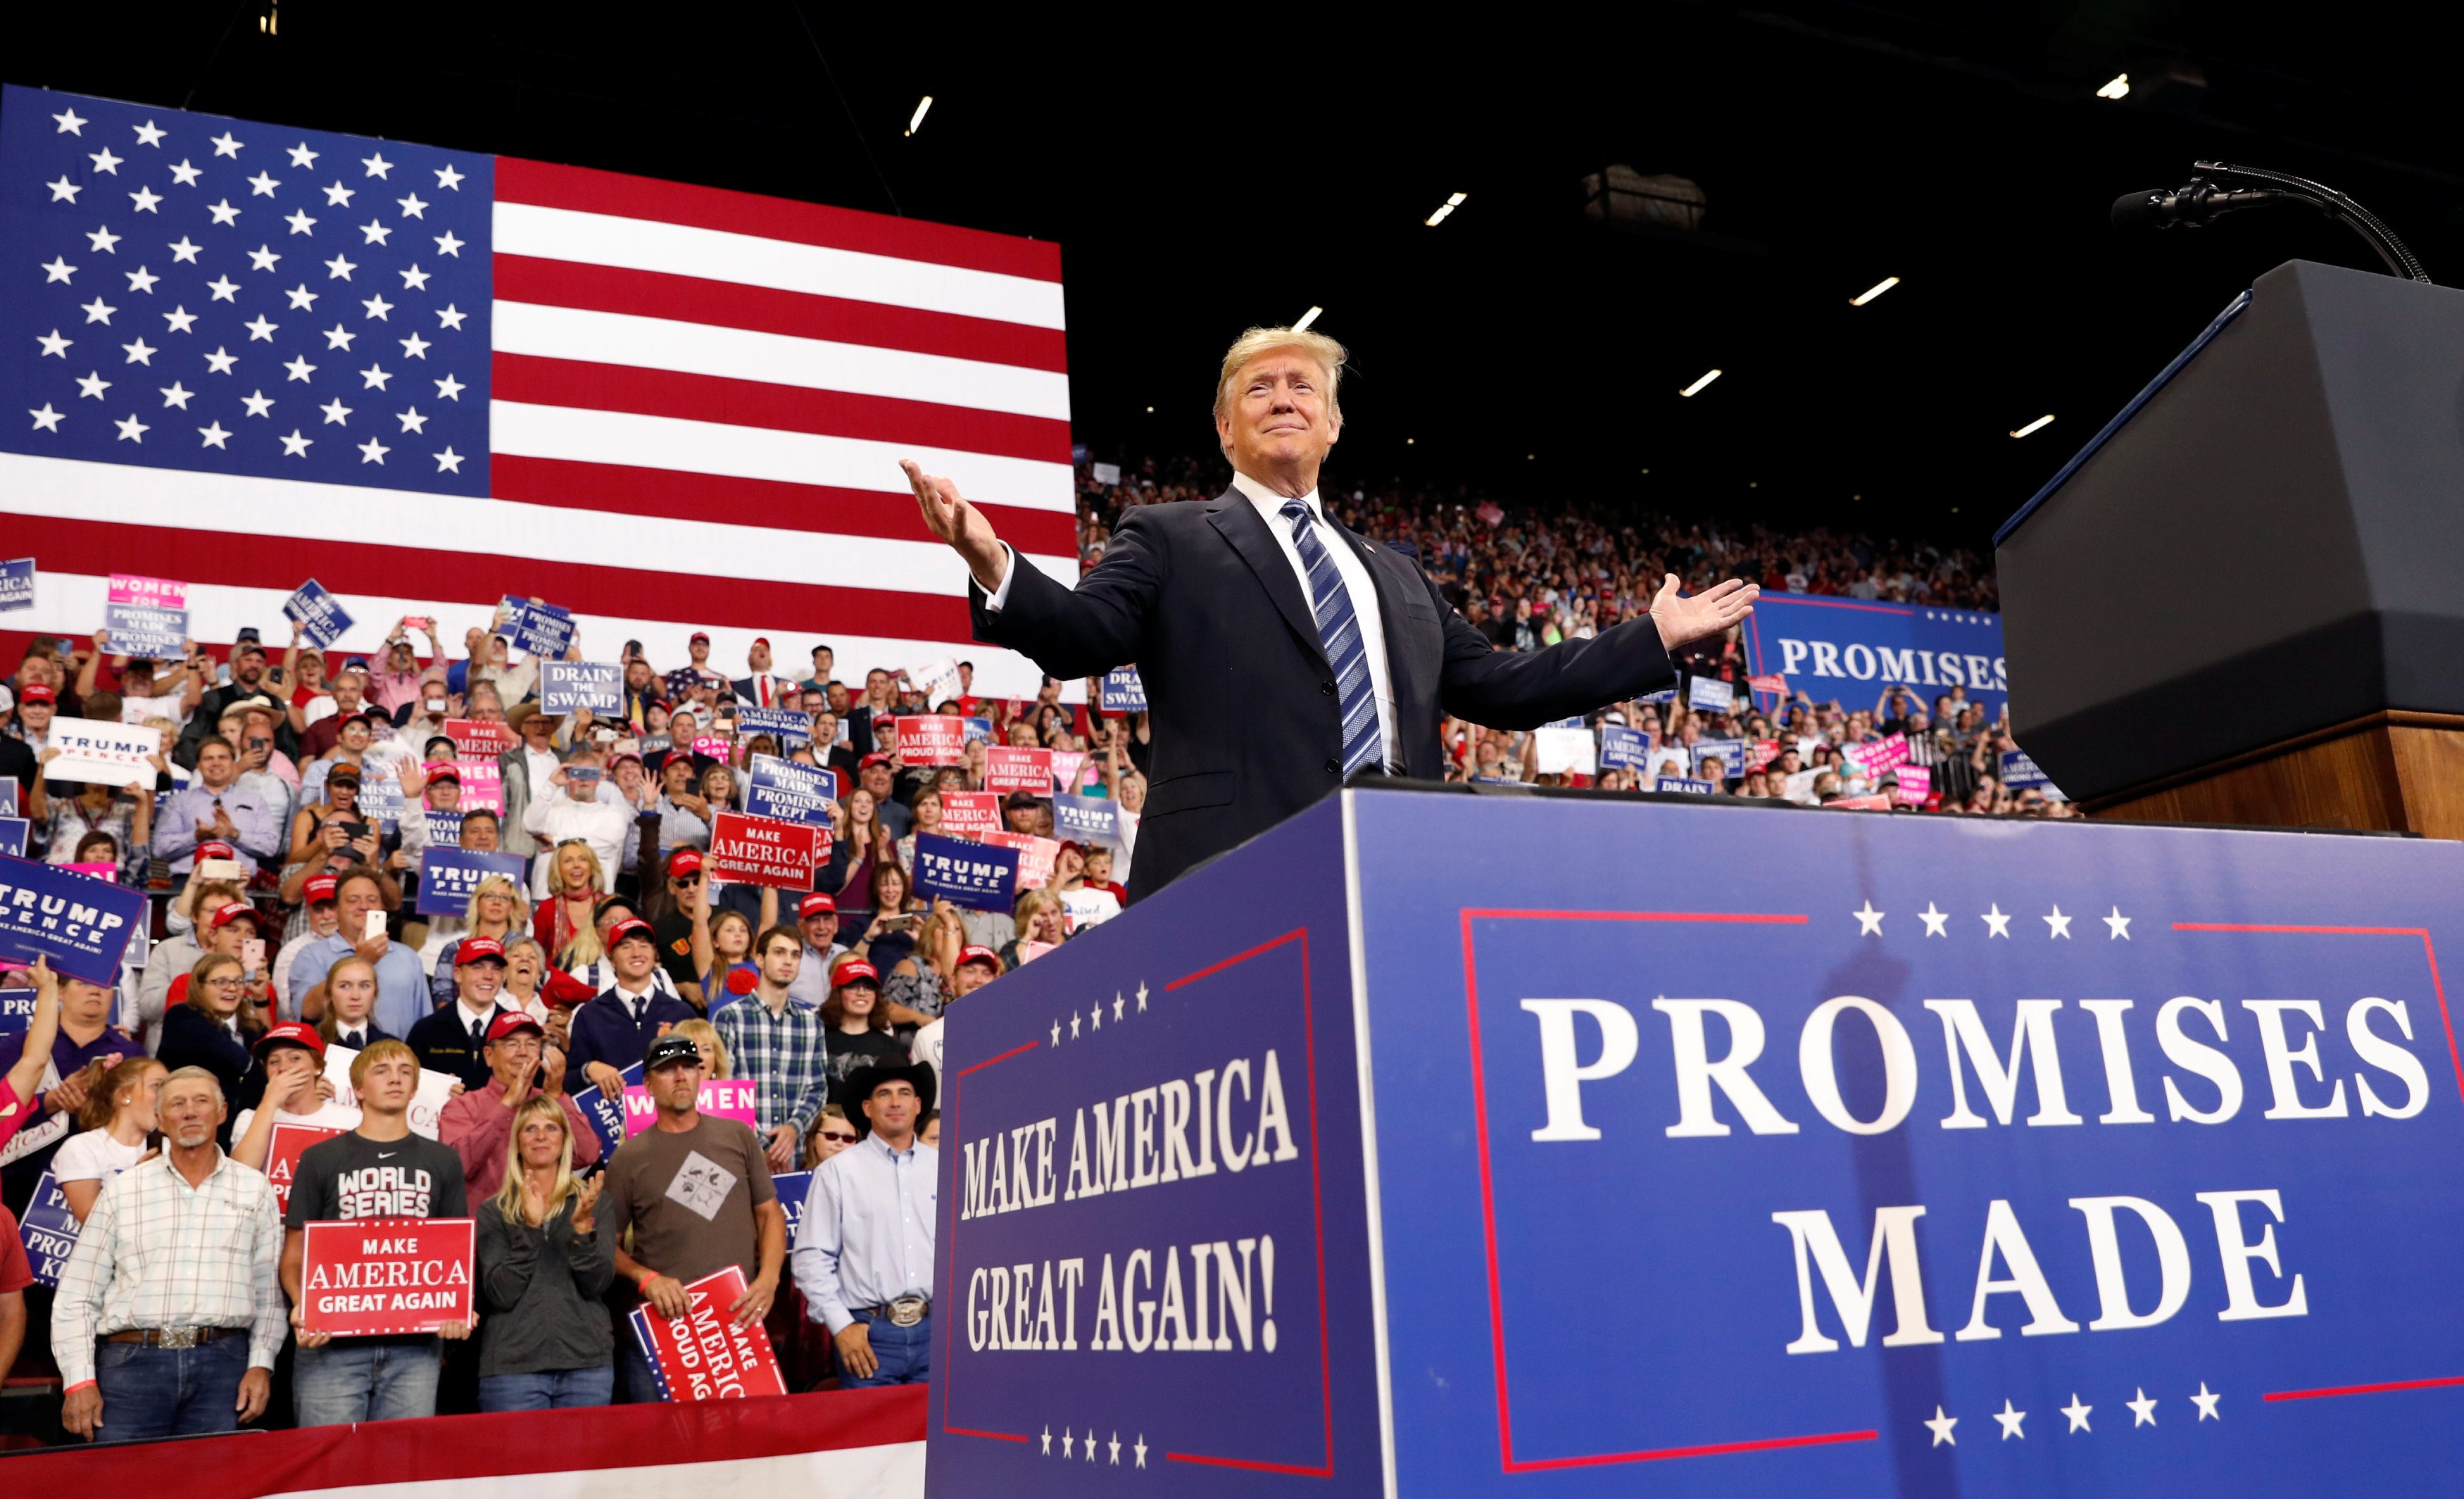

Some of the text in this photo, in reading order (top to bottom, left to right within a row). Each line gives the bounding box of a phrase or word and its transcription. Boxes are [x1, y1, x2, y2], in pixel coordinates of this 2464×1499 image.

[110, 578, 186, 597] WOMEN
[552, 667, 613, 682] DRAIN
[1110, 672, 1140, 684] DRA
[572, 682, 596, 692] THE
[547, 692, 617, 708] SWAMP
[741, 710, 809, 725] AMERICA
[470, 728, 497, 736] MAKE
[919, 723, 944, 732] MAKE
[61, 736, 148, 753] TRUMP
[899, 733, 964, 746] AMERICA
[1852, 735, 1905, 758] WOMEN
[68, 748, 139, 763] PENCE
[900, 747, 934, 757] PROUD
[1008, 755, 1031, 763] MAKE
[761, 763, 829, 787] PROMISES
[988, 764, 1052, 778] AMERICA
[991, 777, 1048, 787] GREAT AGAIN
[1661, 780, 1708, 794] DRAIN
[756, 789, 827, 812] PROMISES
[950, 799, 974, 808] MAKE
[770, 803, 809, 820] KEPT
[942, 809, 998, 822] MERICA
[1058, 805, 1114, 822] TRUMP
[1064, 817, 1109, 829] PENCE
[746, 827, 781, 843] MAKE
[713, 838, 811, 867] AMERICA
[1007, 840, 1033, 851] MAKE
[719, 859, 804, 879] GREAT AGAIN
[922, 853, 1009, 879] TRUMP
[435, 881, 477, 892] PEN
[927, 869, 999, 888] PENCE
[0, 884, 123, 930] TRUMP
[0, 905, 104, 944] PENCE
[11, 926, 46, 937] AMERICA
[46, 934, 74, 946] GREAT
[1520, 995, 2430, 1142] PROMISES
[627, 1087, 755, 1116] WMEN
[594, 1098, 619, 1138] SAFE
[962, 1049, 1297, 1221] MAKE AMERICA
[339, 1167, 431, 1197] WORLD
[339, 1191, 431, 1220] SERIES
[363, 1238, 417, 1255] MAKE
[307, 1260, 468, 1290] AMERICA
[1772, 1189, 2308, 1354] MADE
[318, 1291, 456, 1314] GREAT AGAIN
[967, 1235, 1277, 1353] GREAT AGAIN!
[669, 1317, 700, 1368] ROUD
[687, 1291, 746, 1399] AMERIC
[728, 1322, 758, 1371] MAKE
